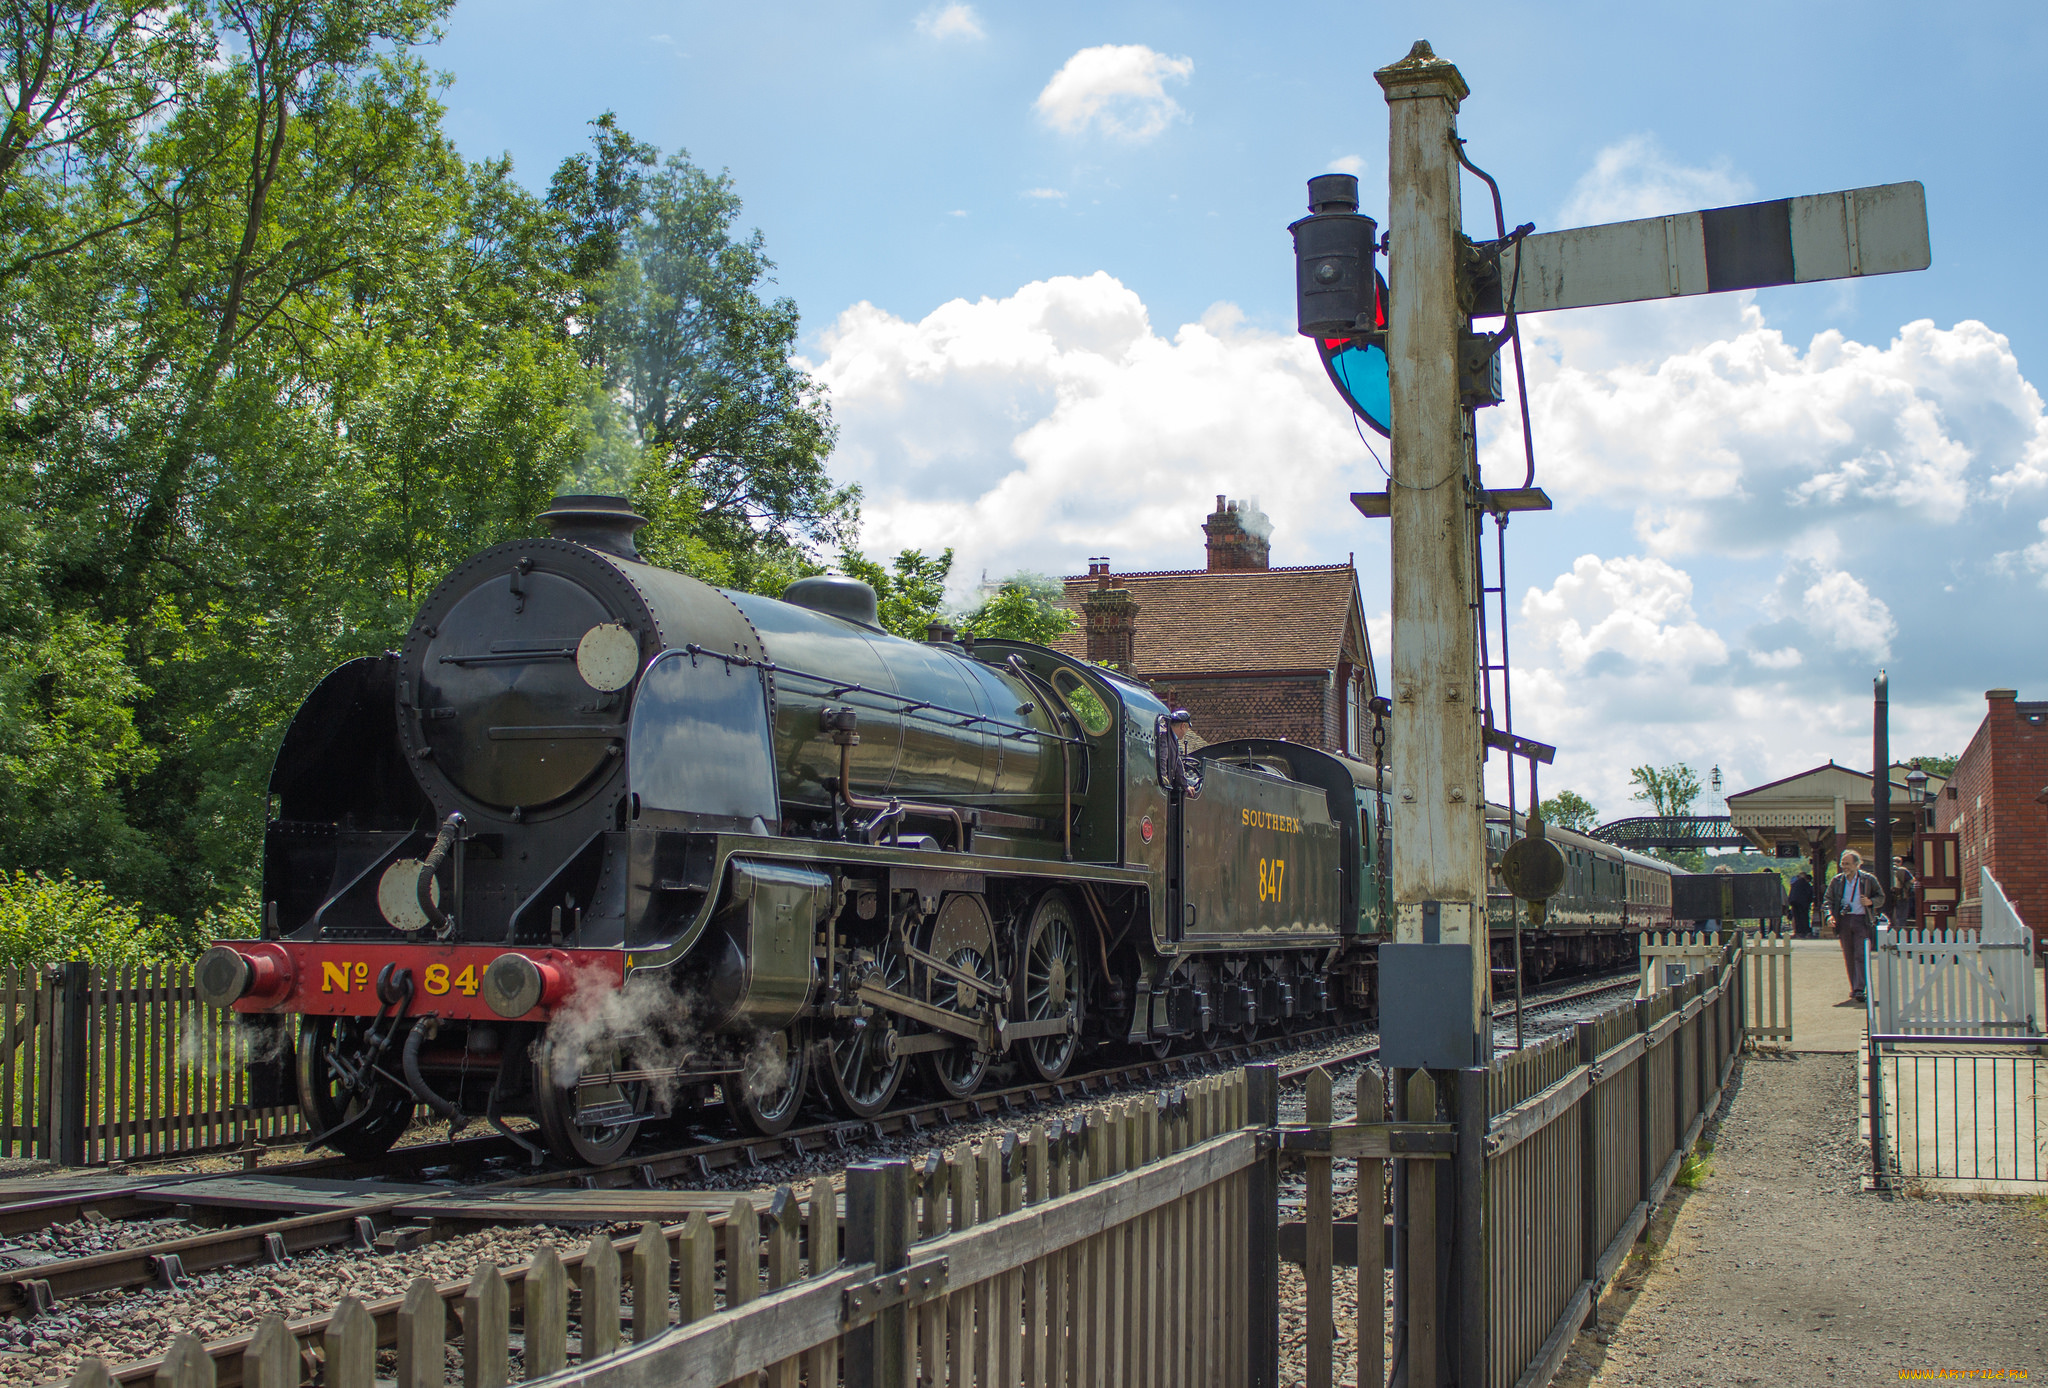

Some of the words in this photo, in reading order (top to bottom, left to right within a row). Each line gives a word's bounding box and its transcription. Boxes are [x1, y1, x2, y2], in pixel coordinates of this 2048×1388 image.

[1241, 808, 1299, 833] SOUTHERN
[1259, 857, 1285, 903] 847
[626, 954, 634, 968] A
[424, 963, 490, 996] 84
